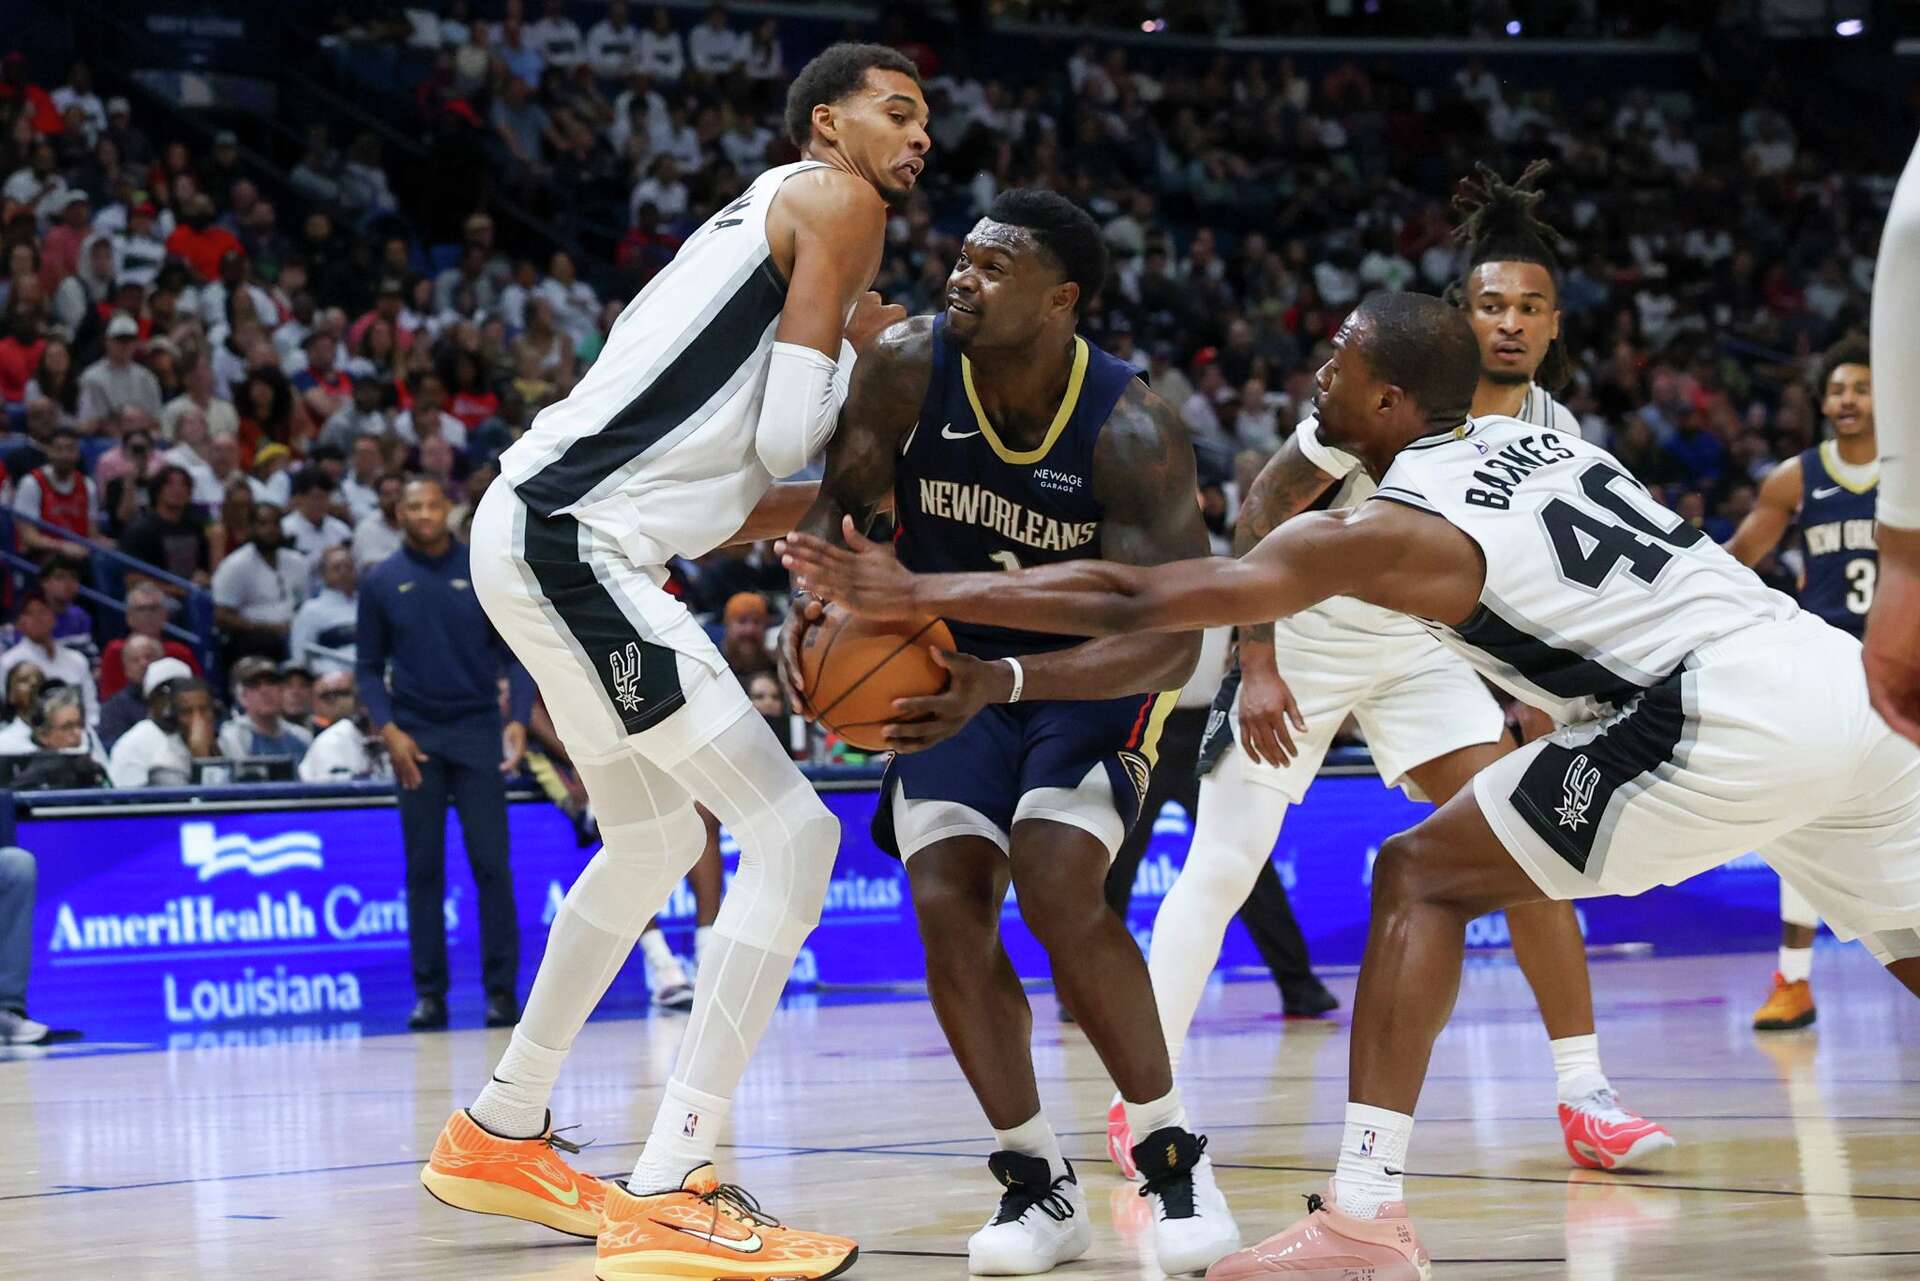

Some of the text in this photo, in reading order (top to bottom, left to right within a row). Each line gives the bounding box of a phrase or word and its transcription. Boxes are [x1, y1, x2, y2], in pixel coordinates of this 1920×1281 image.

[1040, 481, 1074, 493] GARAGE
[1465, 432, 1575, 510] BARNES
[1535, 457, 1706, 596] 40
[1845, 557, 1877, 615] 3
[50, 884, 460, 952] AmeriHealth Caris
[164, 965, 362, 1022] Louisiana
